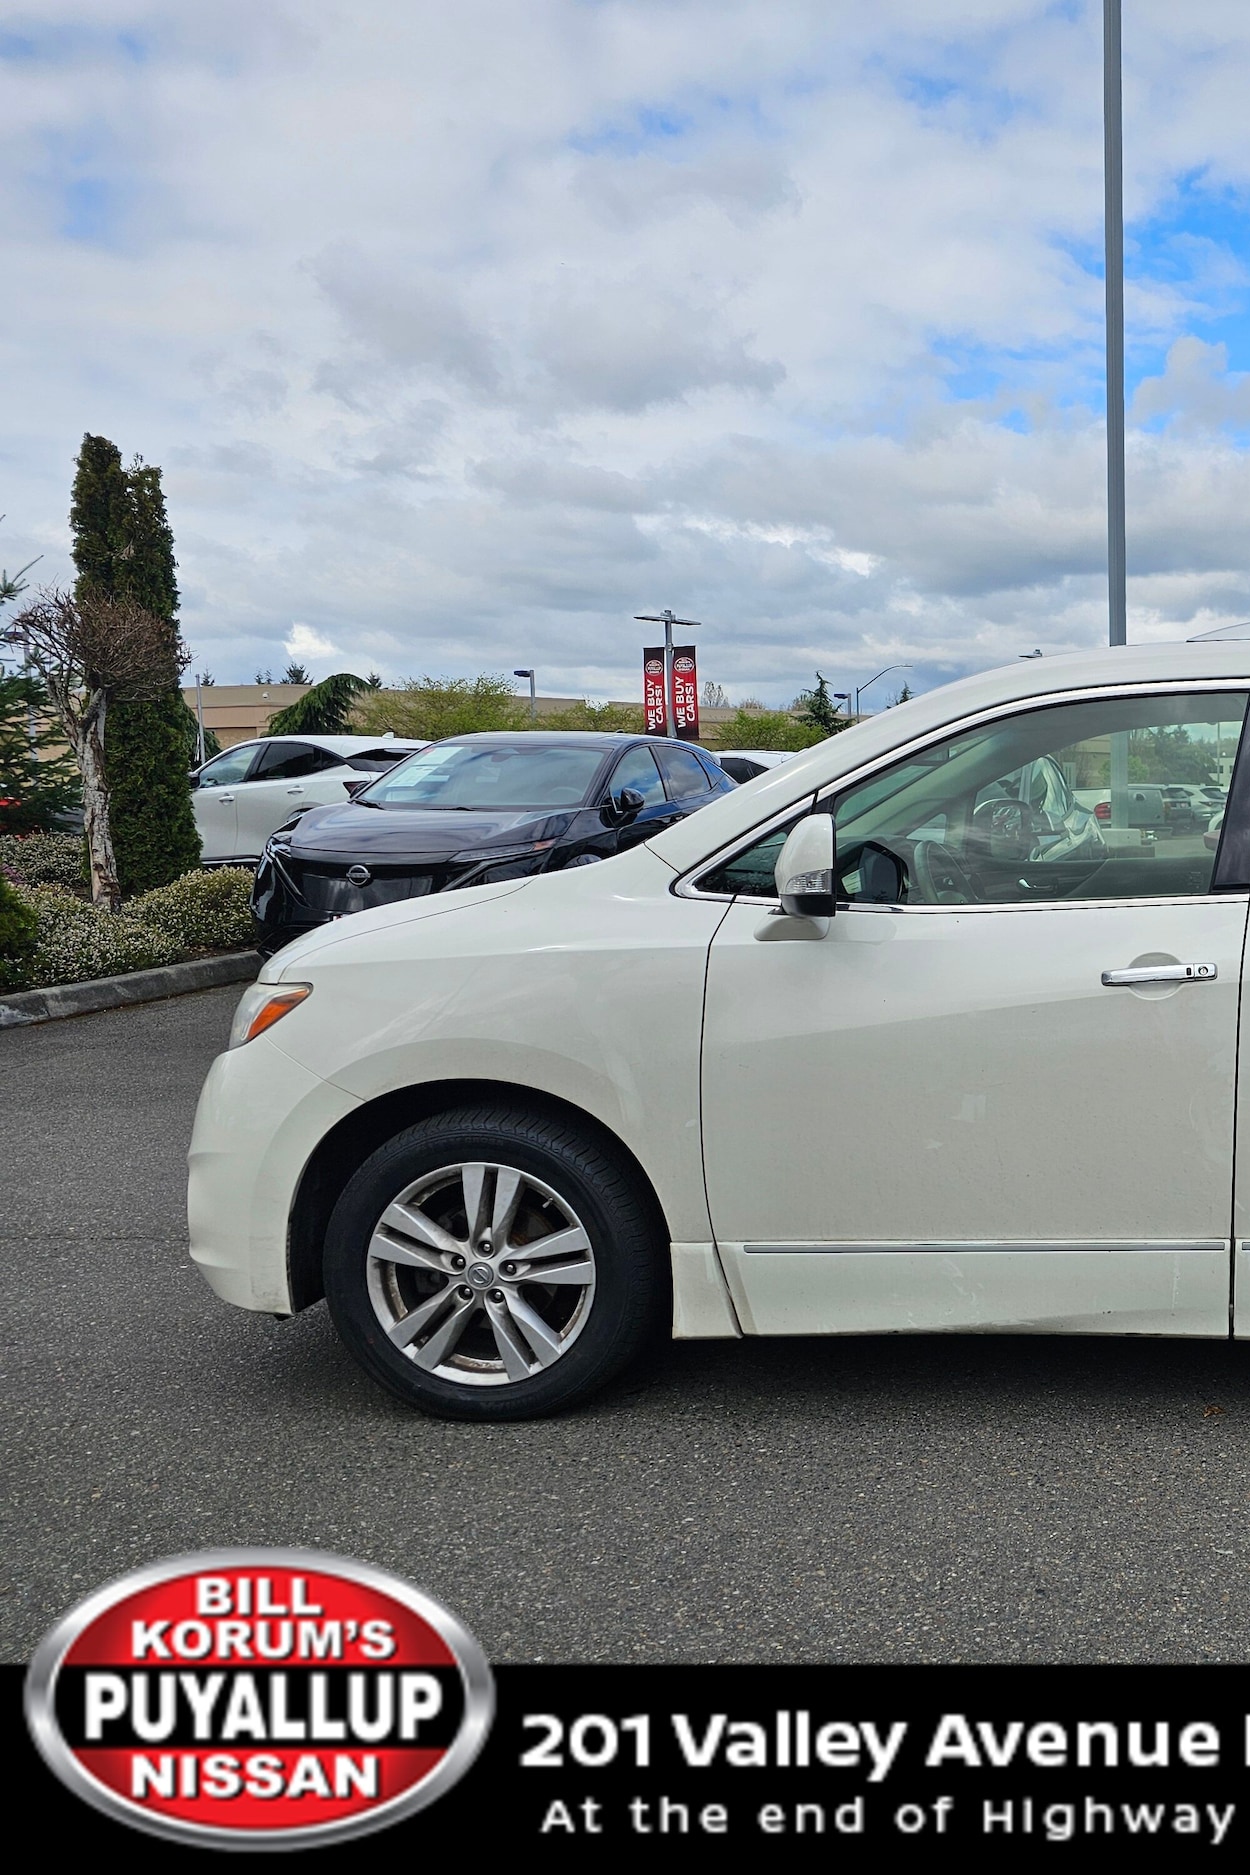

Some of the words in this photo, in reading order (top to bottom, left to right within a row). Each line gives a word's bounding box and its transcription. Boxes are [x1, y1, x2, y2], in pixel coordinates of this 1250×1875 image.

[647, 679, 655, 706] BUY
[675, 676, 685, 704] BUY
[685, 683, 695, 721] CARS!
[655, 685, 664, 724] CARS!
[676, 707, 687, 728] WE
[648, 709, 656, 730] WE
